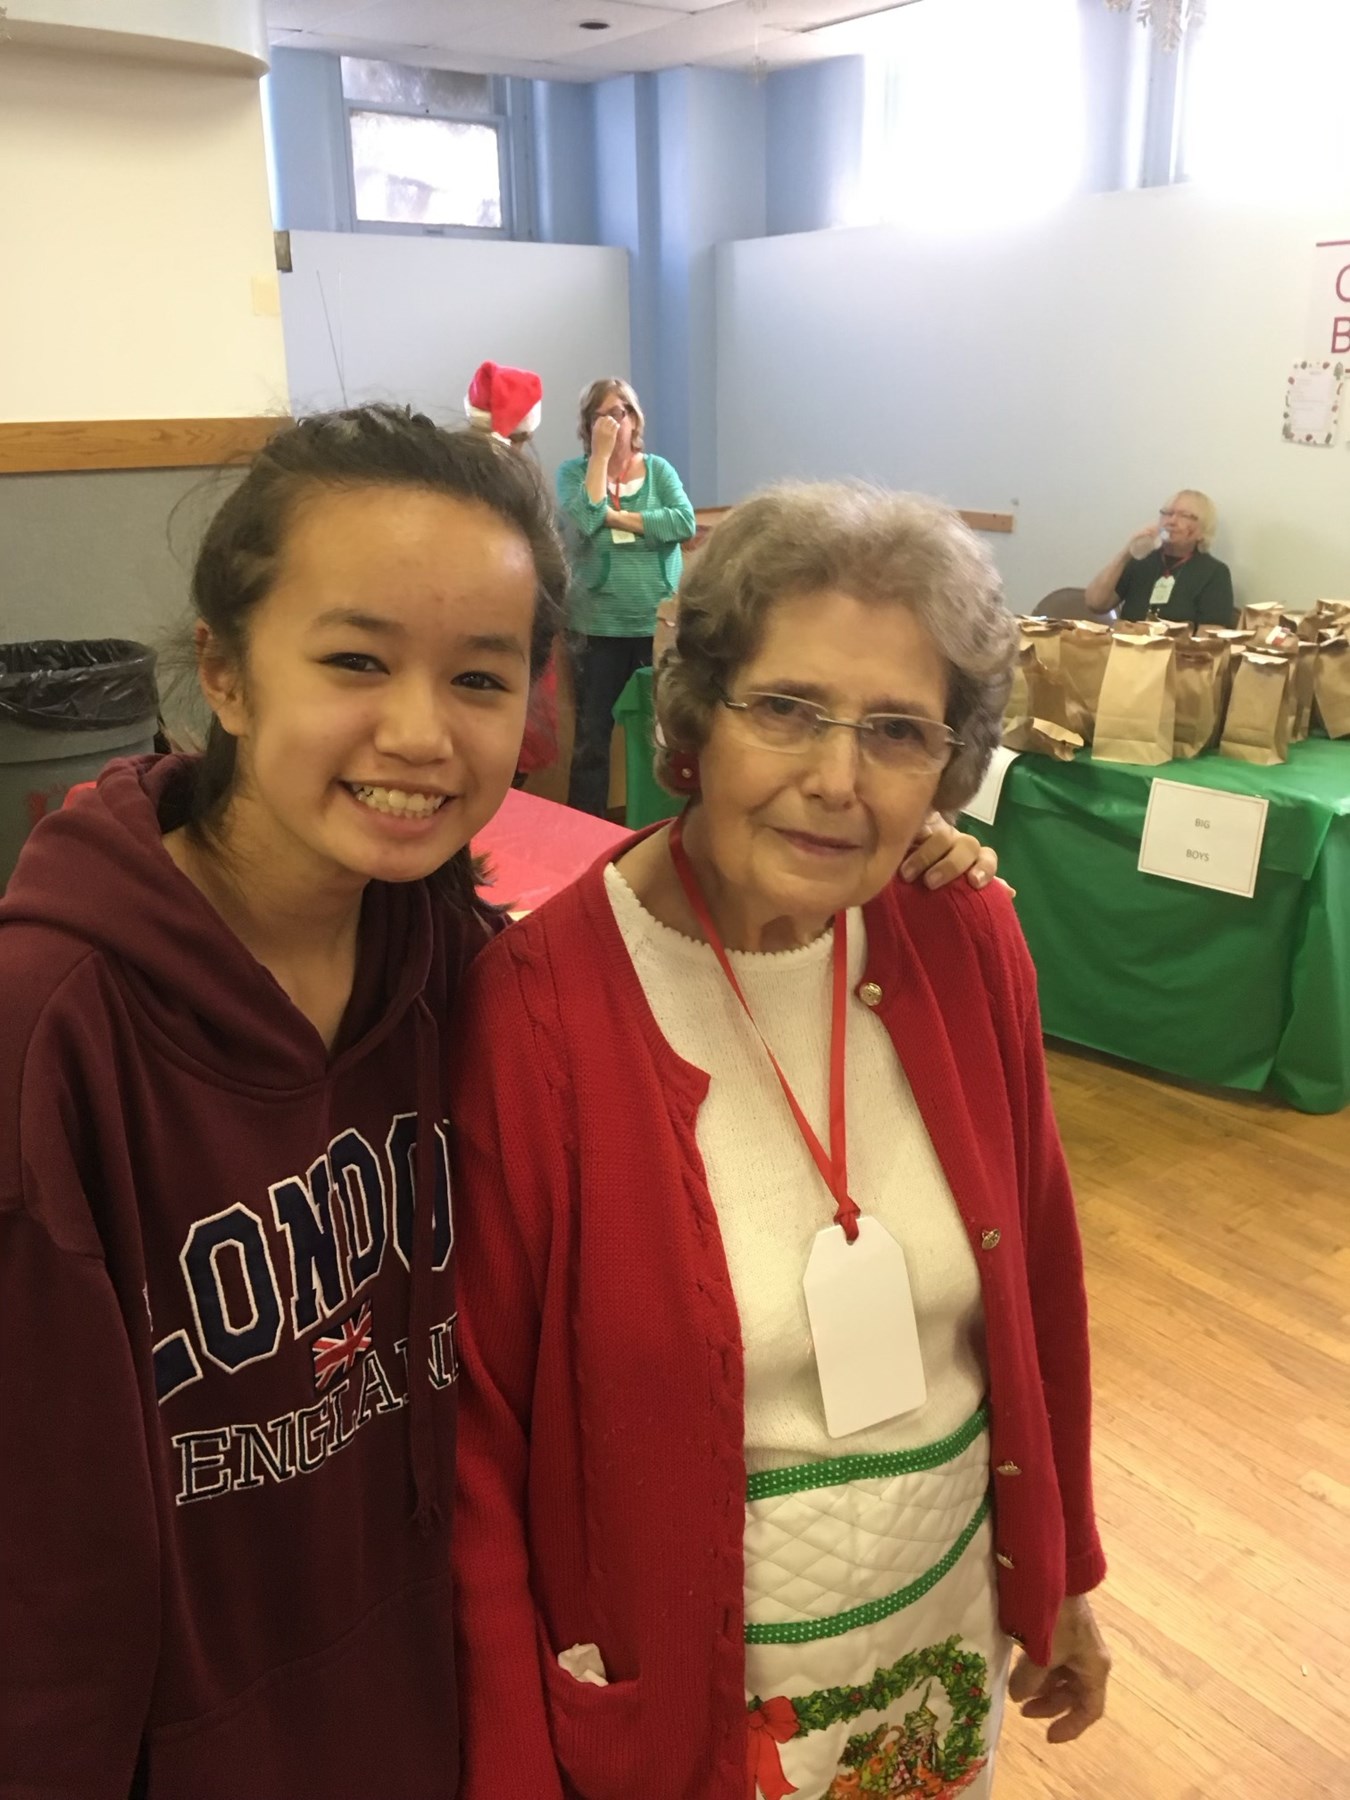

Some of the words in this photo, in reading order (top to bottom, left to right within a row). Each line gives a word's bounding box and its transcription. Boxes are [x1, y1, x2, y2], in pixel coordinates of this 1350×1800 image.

[1194, 818, 1211, 829] BIG
[1186, 849, 1210, 862] BOYS
[142, 1112, 454, 1407] ONDO
